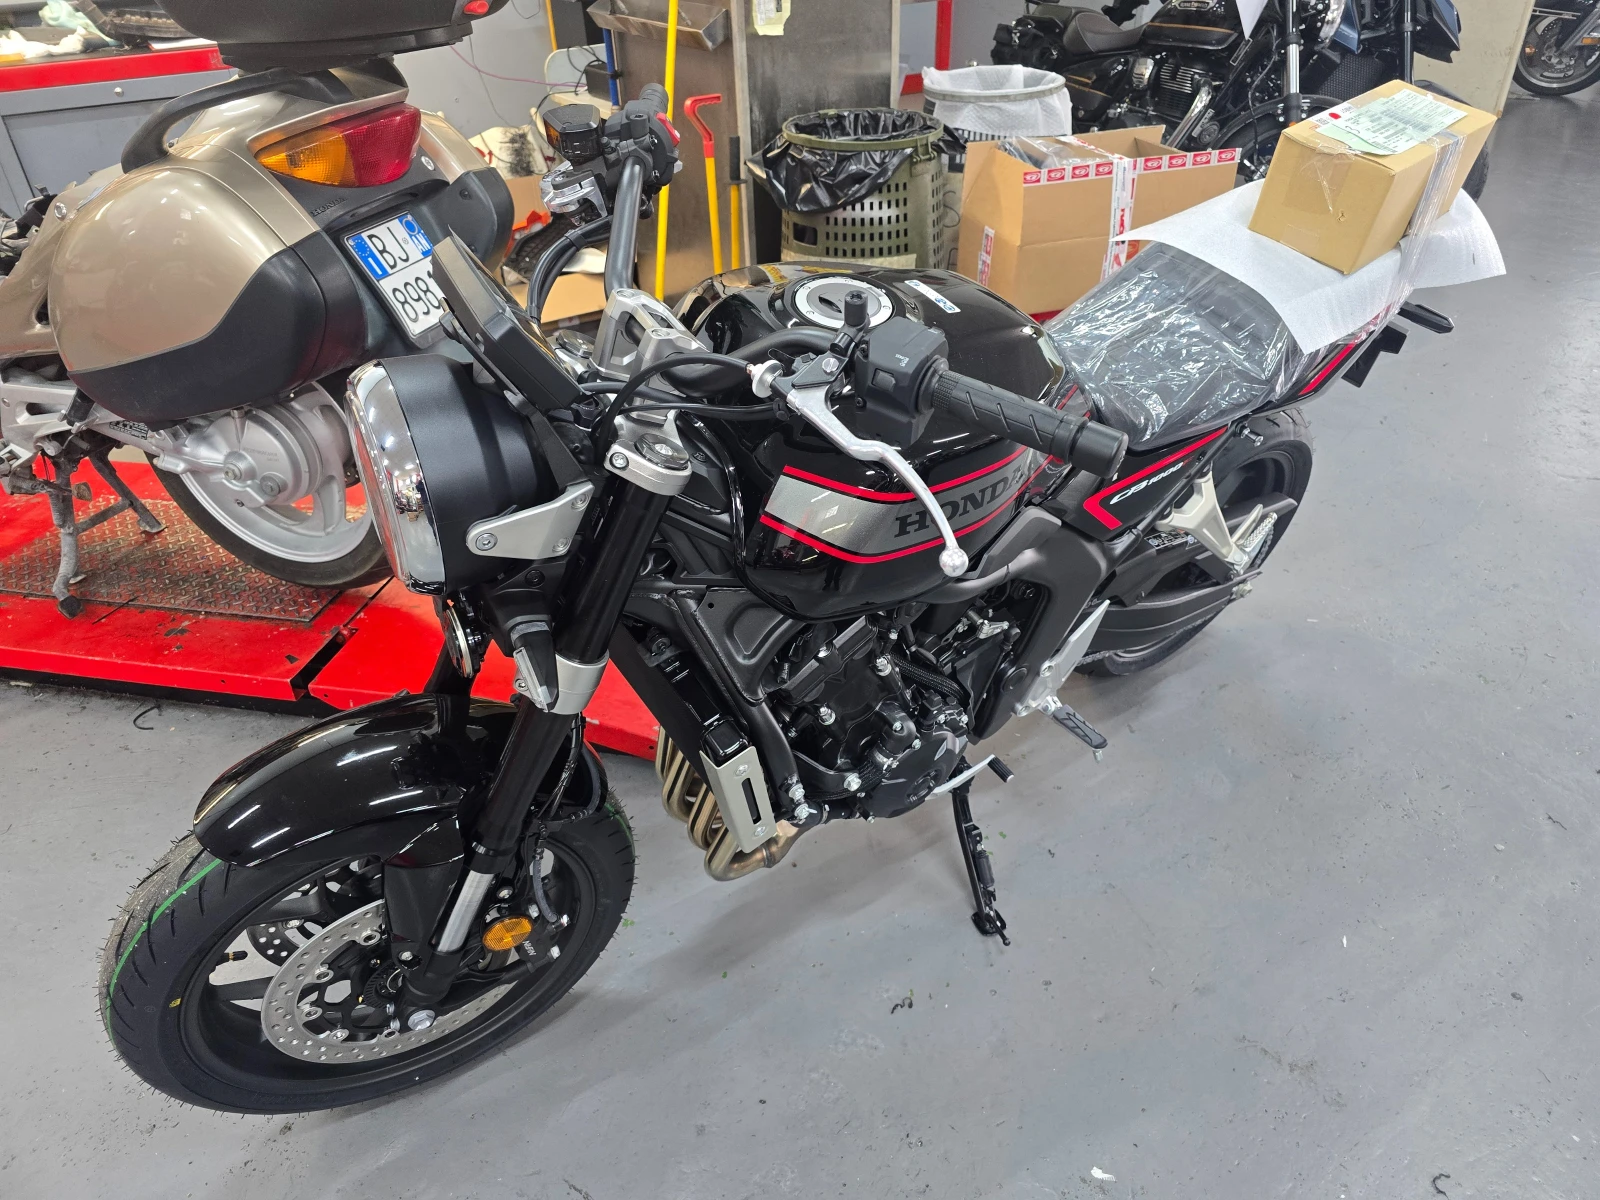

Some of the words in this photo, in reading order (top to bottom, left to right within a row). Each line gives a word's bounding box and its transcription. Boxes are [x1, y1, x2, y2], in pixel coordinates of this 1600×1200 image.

[366, 226, 410, 271] BJ
[391, 270, 441, 323] 898
[894, 464, 1024, 538] HONDA
